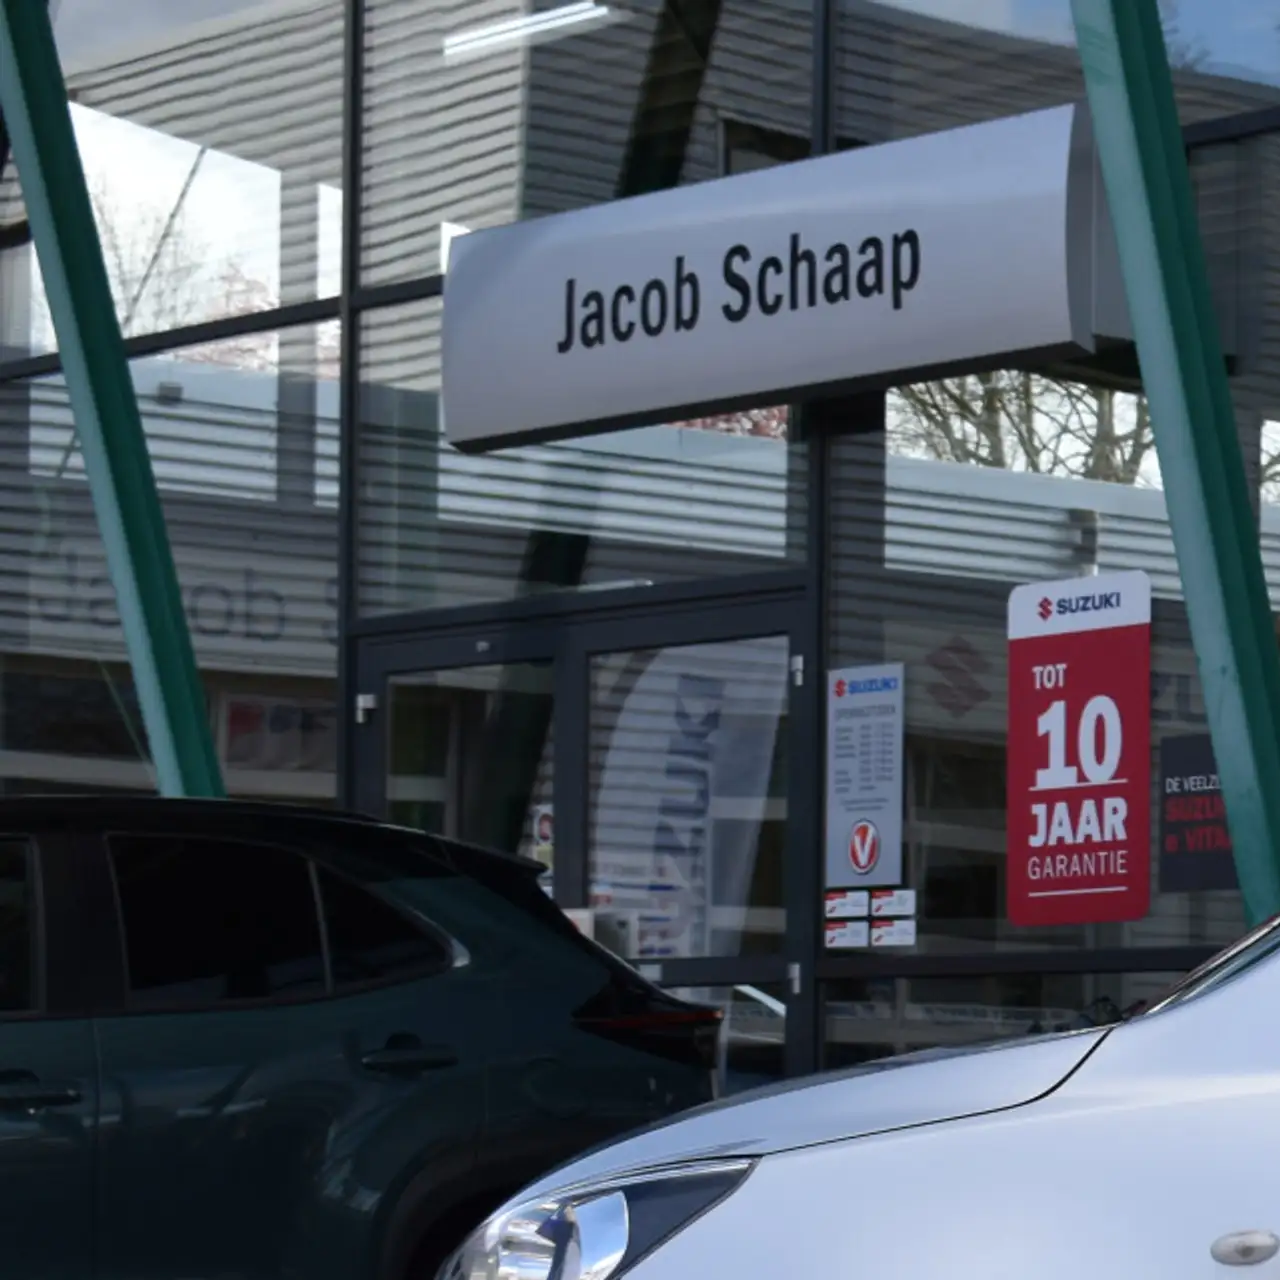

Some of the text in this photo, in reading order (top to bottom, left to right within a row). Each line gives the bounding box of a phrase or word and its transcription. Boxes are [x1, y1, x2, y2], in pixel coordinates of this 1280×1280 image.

[557, 228, 921, 354] Jacob Schaap
[1056, 591, 1121, 616] SUZUKI
[848, 676, 898, 695] SUZUKI
[1032, 662, 1067, 691] TOT
[1035, 694, 1122, 790] 10
[1165, 776, 1180, 794] DE
[1028, 796, 1128, 848] JAAR
[1027, 850, 1128, 880] GARANTIE
